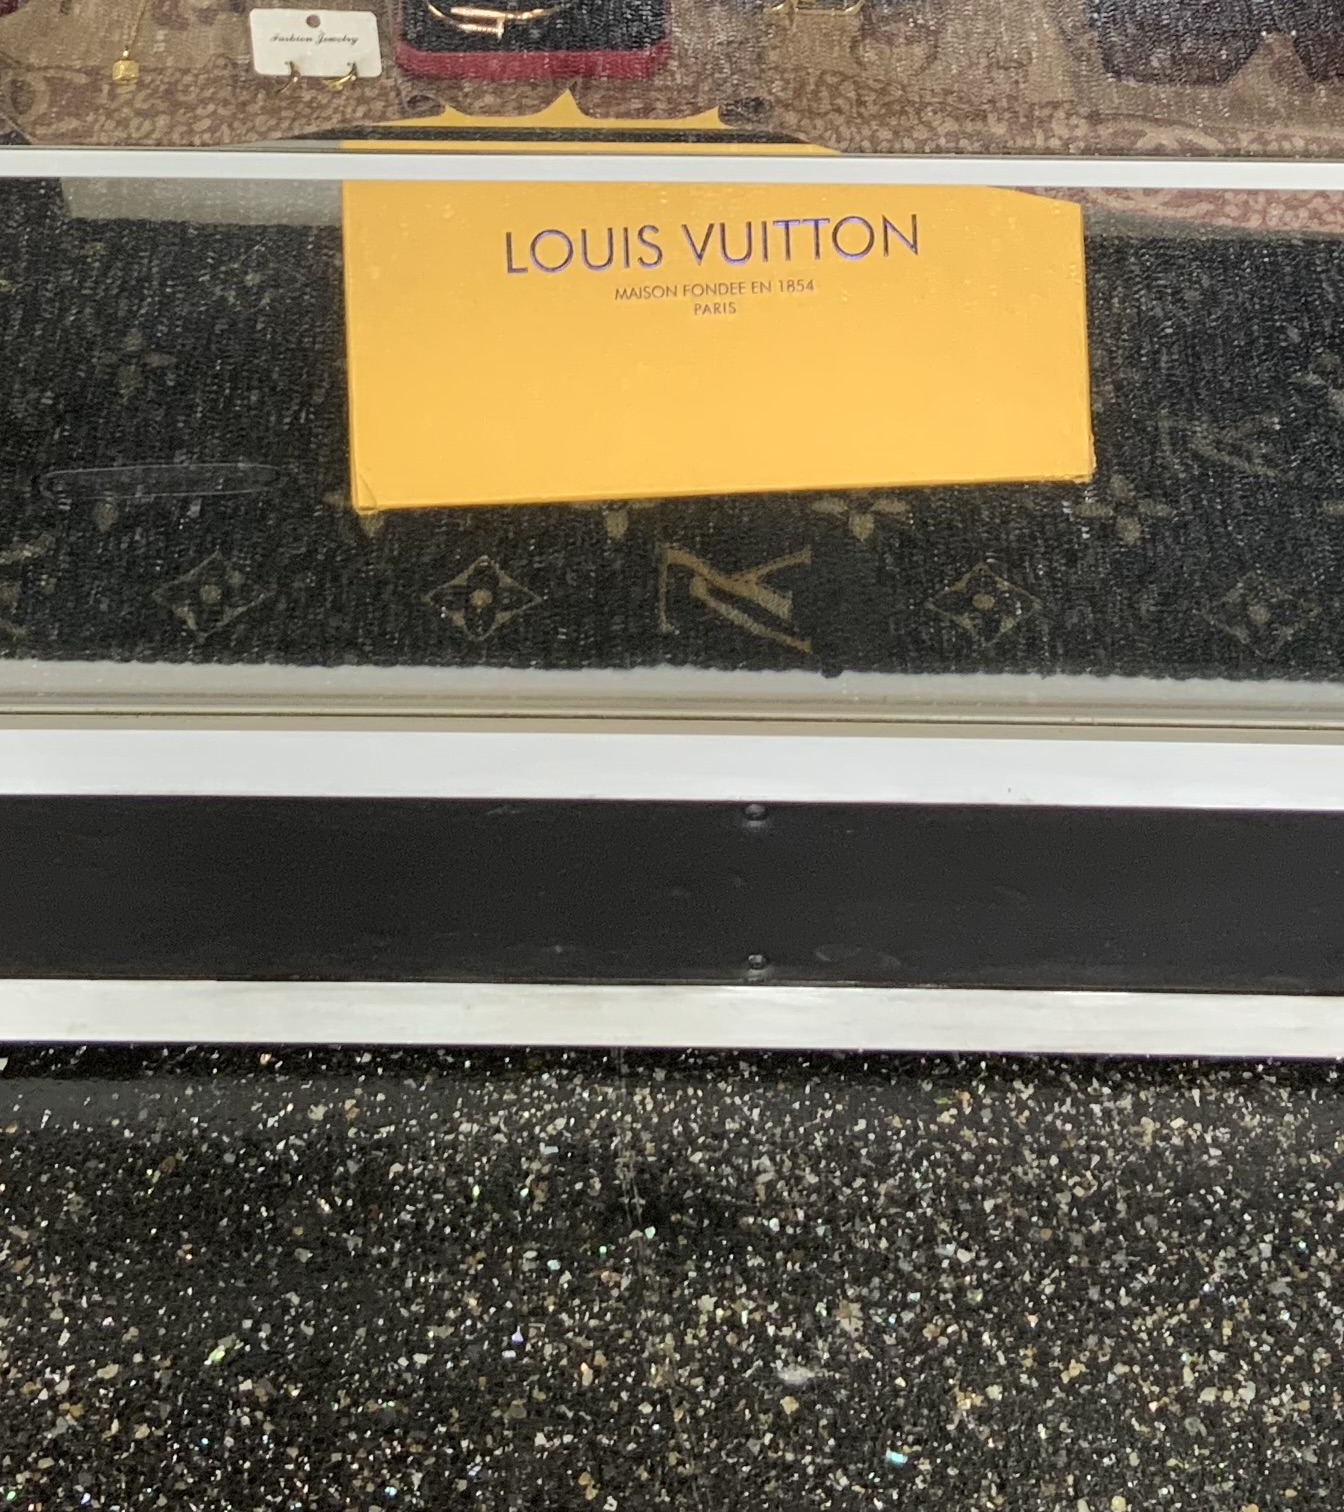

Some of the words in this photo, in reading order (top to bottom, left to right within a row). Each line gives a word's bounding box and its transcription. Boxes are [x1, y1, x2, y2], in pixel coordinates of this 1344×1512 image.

[269, 32, 313, 43] Fashion
[315, 30, 360, 46] Jewelry
[505, 223, 664, 275] LOUIS
[680, 213, 920, 266] VUITTON
[614, 284, 678, 300] MAISON
[751, 280, 773, 294] EN
[777, 279, 815, 292] 1854
[693, 301, 738, 316] PARIS
